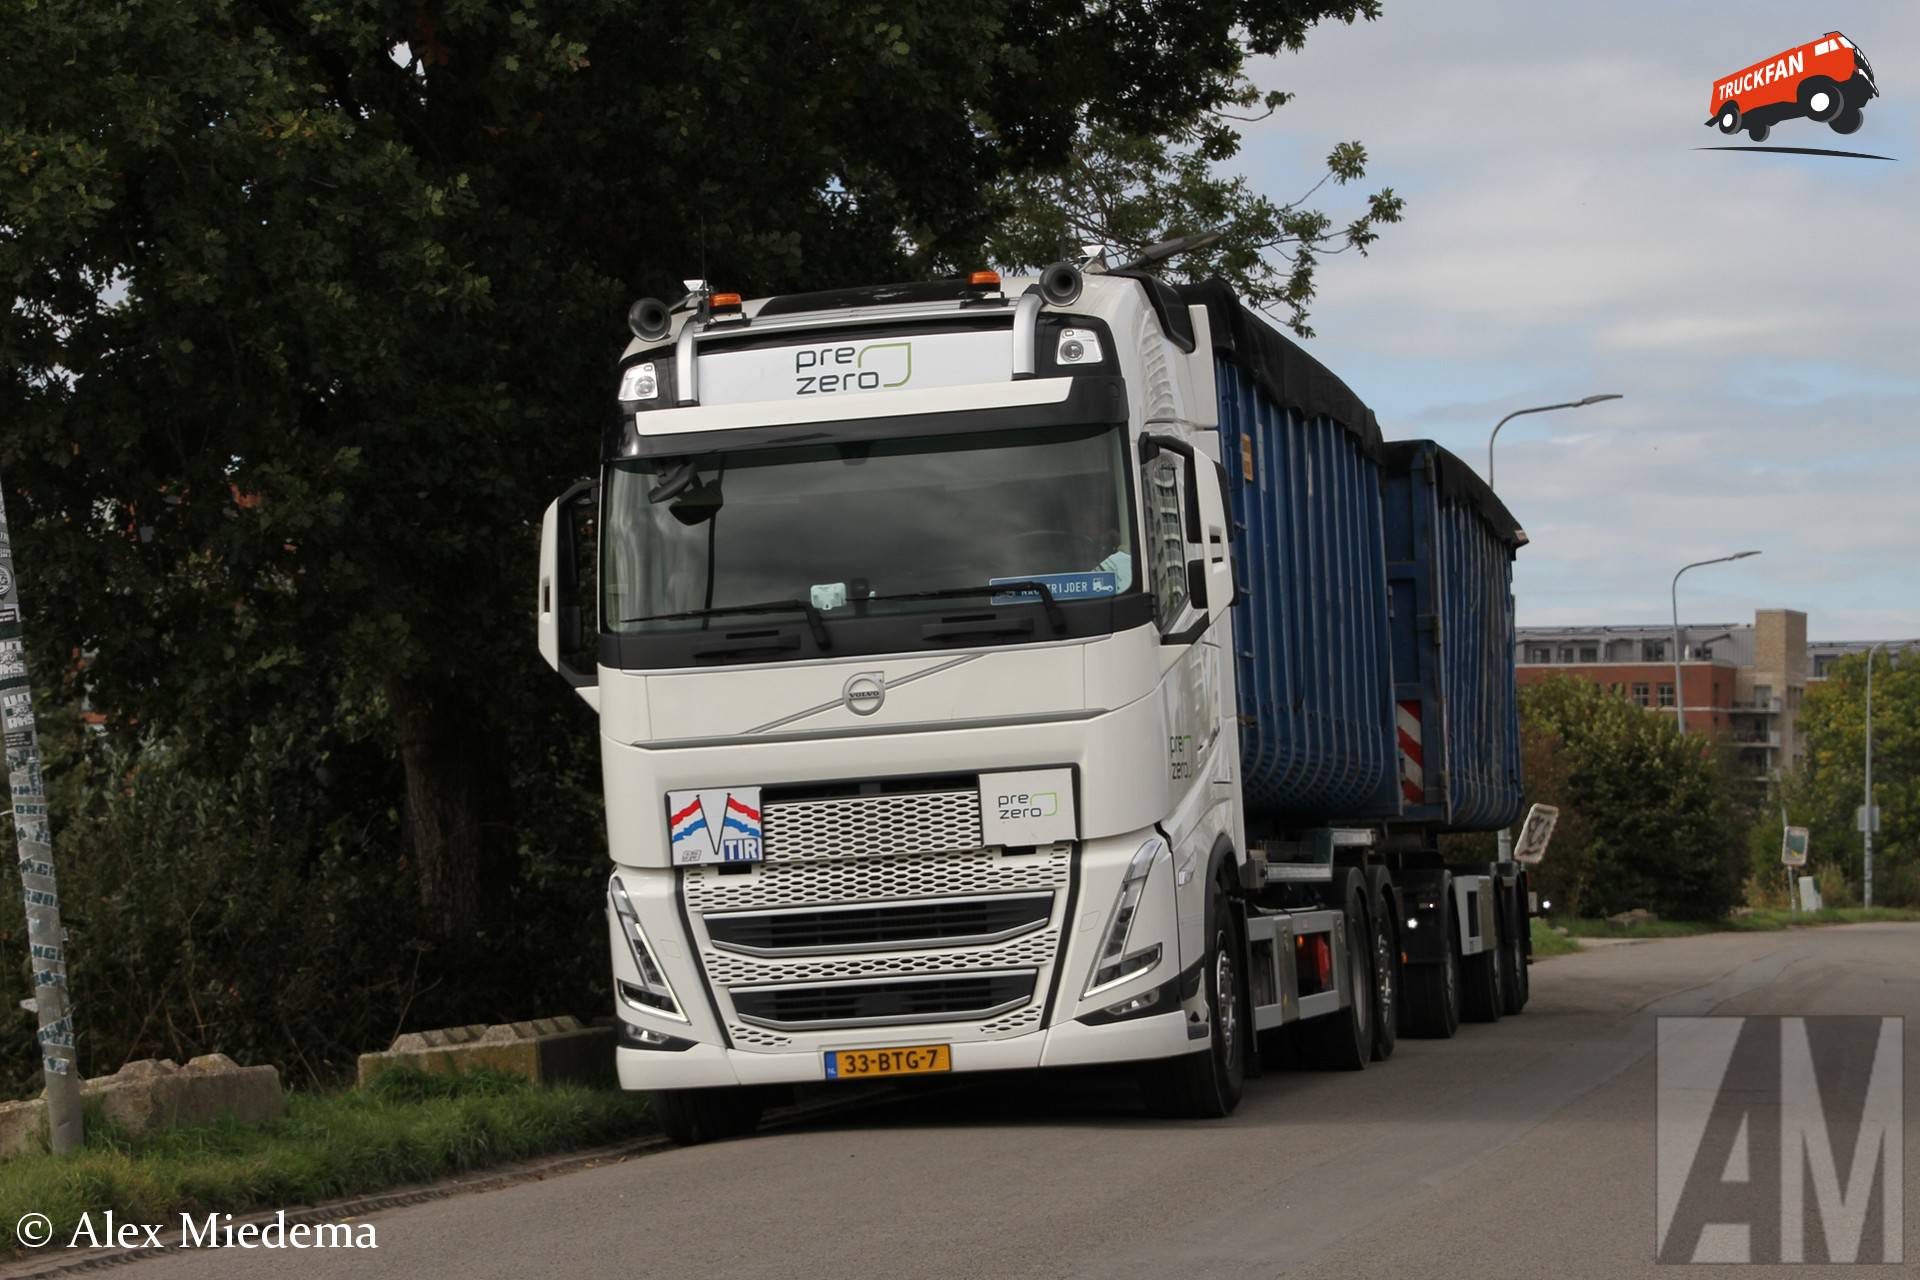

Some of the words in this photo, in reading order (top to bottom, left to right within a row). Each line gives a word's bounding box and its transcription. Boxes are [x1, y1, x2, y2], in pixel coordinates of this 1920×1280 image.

[796, 346, 856, 374] pre
[796, 371, 879, 395] zero
[848, 690, 880, 698] VOLVO
[998, 794, 1030, 808] pre
[999, 807, 1042, 820] zero
[724, 838, 759, 861] TIR
[844, 1048, 938, 1074] 33-BTG-7
